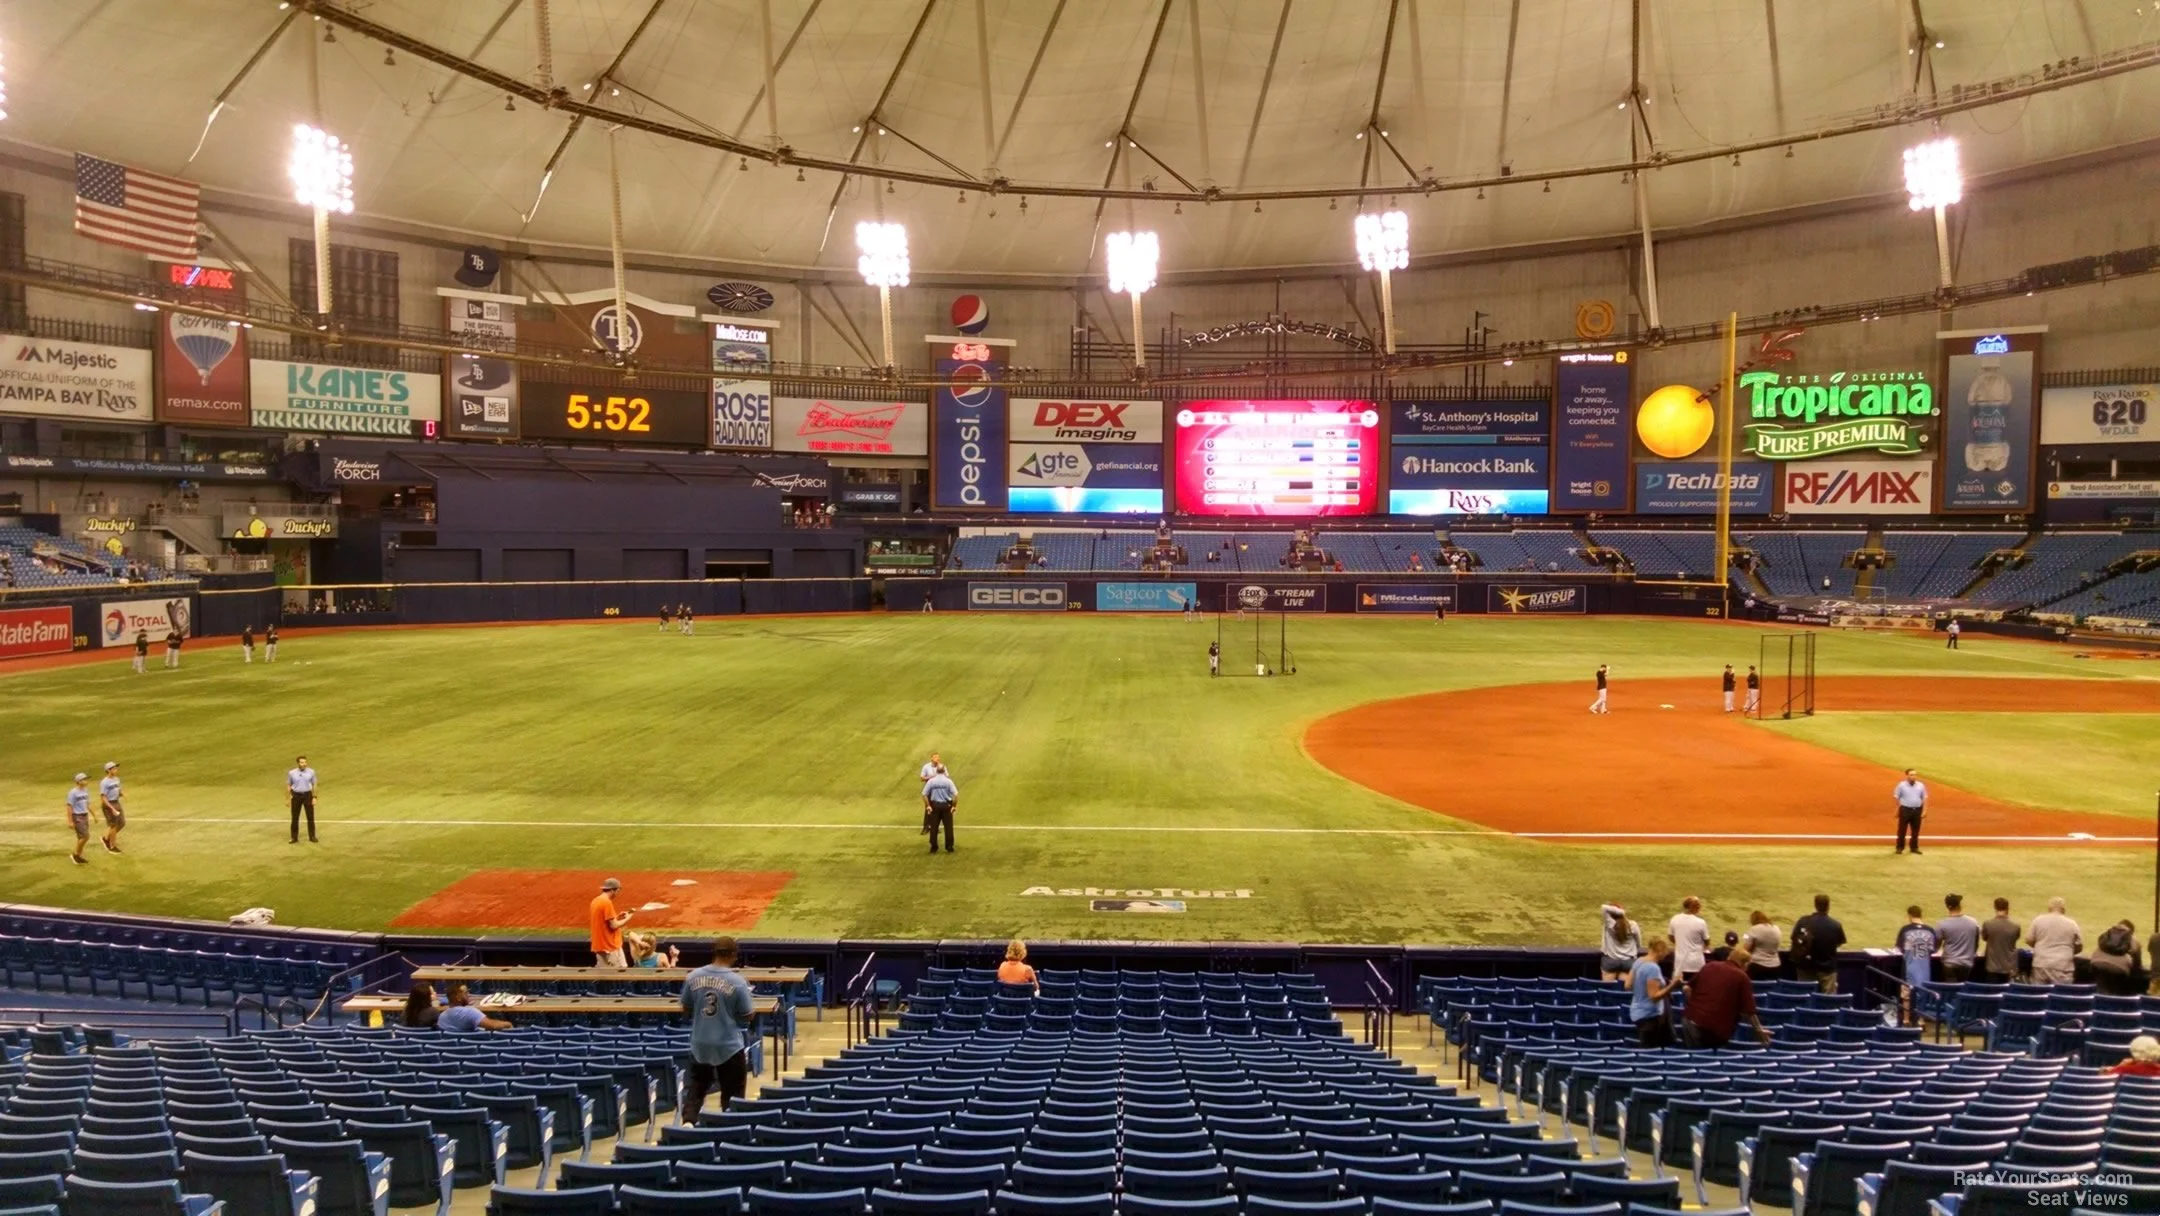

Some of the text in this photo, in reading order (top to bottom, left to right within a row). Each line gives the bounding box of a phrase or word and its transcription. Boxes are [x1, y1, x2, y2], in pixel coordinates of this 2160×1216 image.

[171, 265, 233, 288] RE/MAX
[47, 348, 117, 370] Majestic
[47, 374, 97, 387] UNIFORM
[100, 378, 114, 388] OF
[117, 380, 136, 390] THE
[287, 364, 410, 402] KANE'S
[1785, 372, 1925, 384] THE ORIGINAL
[1580, 385, 1606, 394] home
[1739, 371, 1932, 423] Tropicana
[61, 390, 93, 405] BAY
[168, 396, 242, 412] remax.com
[292, 399, 404, 415] FURNITURE
[487, 402, 506, 410] NEW
[487, 409, 506, 417] ERA
[567, 393, 651, 432] 5:52
[714, 391, 770, 422] ROSE
[1566, 406, 1620, 416] keeping you
[2093, 399, 2147, 426] 620
[1033, 402, 1130, 428] DEX
[1422, 412, 1539, 425] St. Anthony's Hospital
[1568, 417, 1617, 425] connected.
[714, 420, 770, 447] RADIOLOGY
[1055, 427, 1137, 441] imaging
[1758, 424, 1906, 454] PURE PREMIUM
[955, 416, 986, 505] pepsi
[1042, 452, 1079, 474] gte
[1096, 457, 1158, 471] gtefinancial.org
[1422, 458, 1536, 473] Hancock Bank
[334, 468, 380, 480] PORCH
[794, 478, 827, 488] PORCH
[1787, 470, 1922, 506] RE/MAX
[855, 493, 874, 501] GRAB
[87, 516, 136, 535] Ducky's
[283, 518, 331, 537] Ducky's
[972, 588, 1063, 605] GEICO
[1106, 585, 1162, 604] Sagicor
[1274, 589, 1316, 598] STREAM
[1380, 594, 1451, 602] MicroLumen
[1068, 601, 1082, 609] 370
[1284, 598, 1305, 607] LIVE
[603, 607, 620, 616] 404
[1706, 607, 1719, 616] 322
[74, 636, 88, 647] 370
[1019, 886, 1255, 899] AstroTurf
[703, 990, 718, 1017] 3
